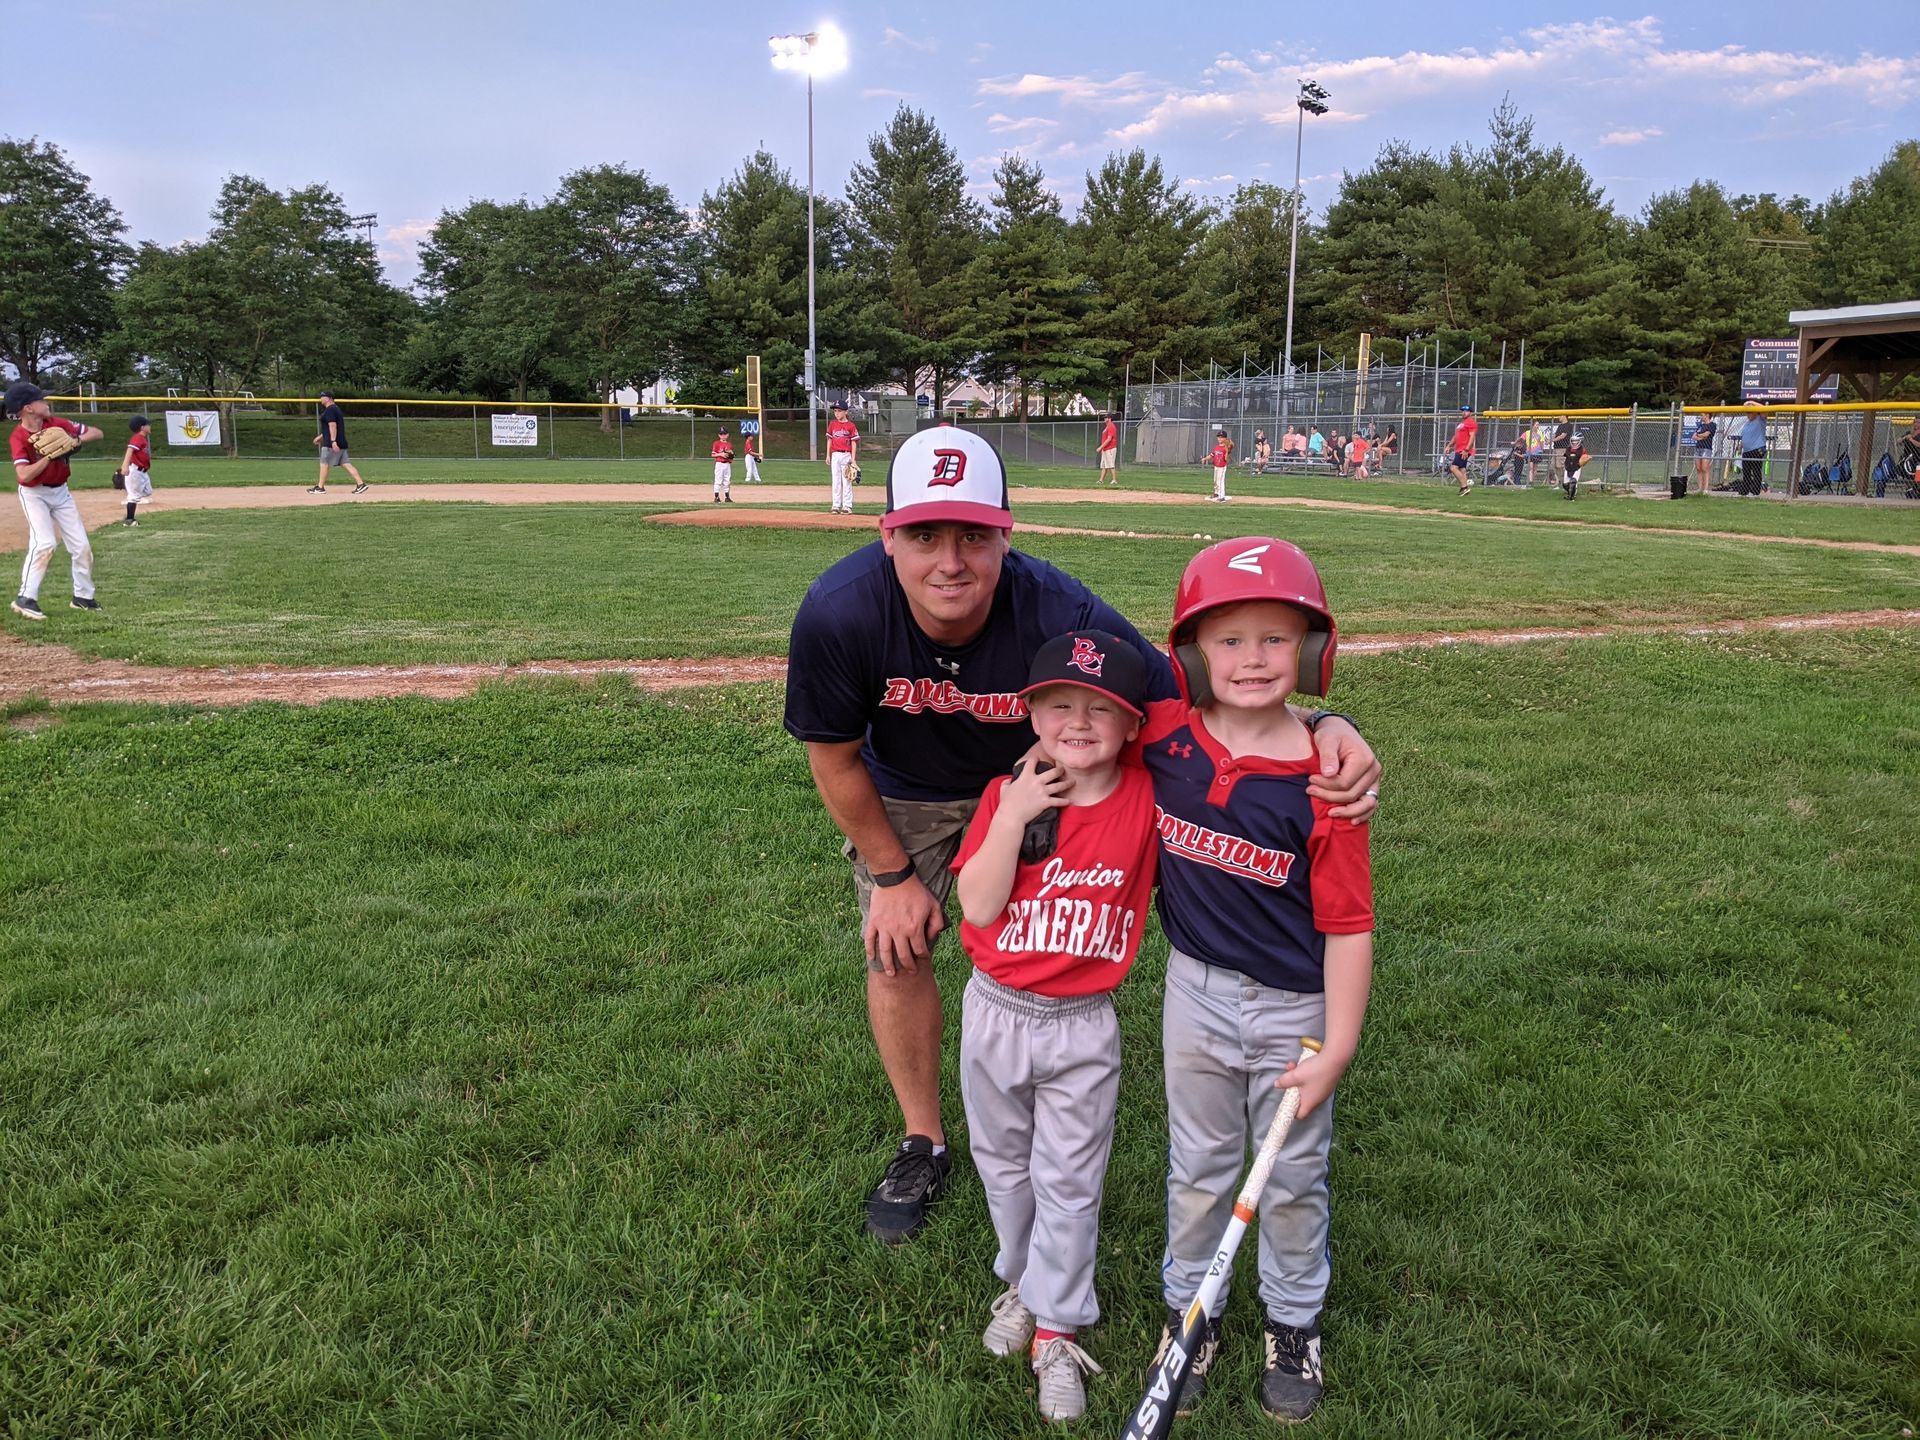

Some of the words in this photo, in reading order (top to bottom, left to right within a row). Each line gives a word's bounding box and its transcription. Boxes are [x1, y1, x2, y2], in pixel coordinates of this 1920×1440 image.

[741, 421, 760, 434] 200
[927, 448, 967, 488] D
[1036, 856, 1125, 898] Junior
[996, 897, 1136, 964] GENERALS
[1126, 1340, 1188, 1440] EAS
